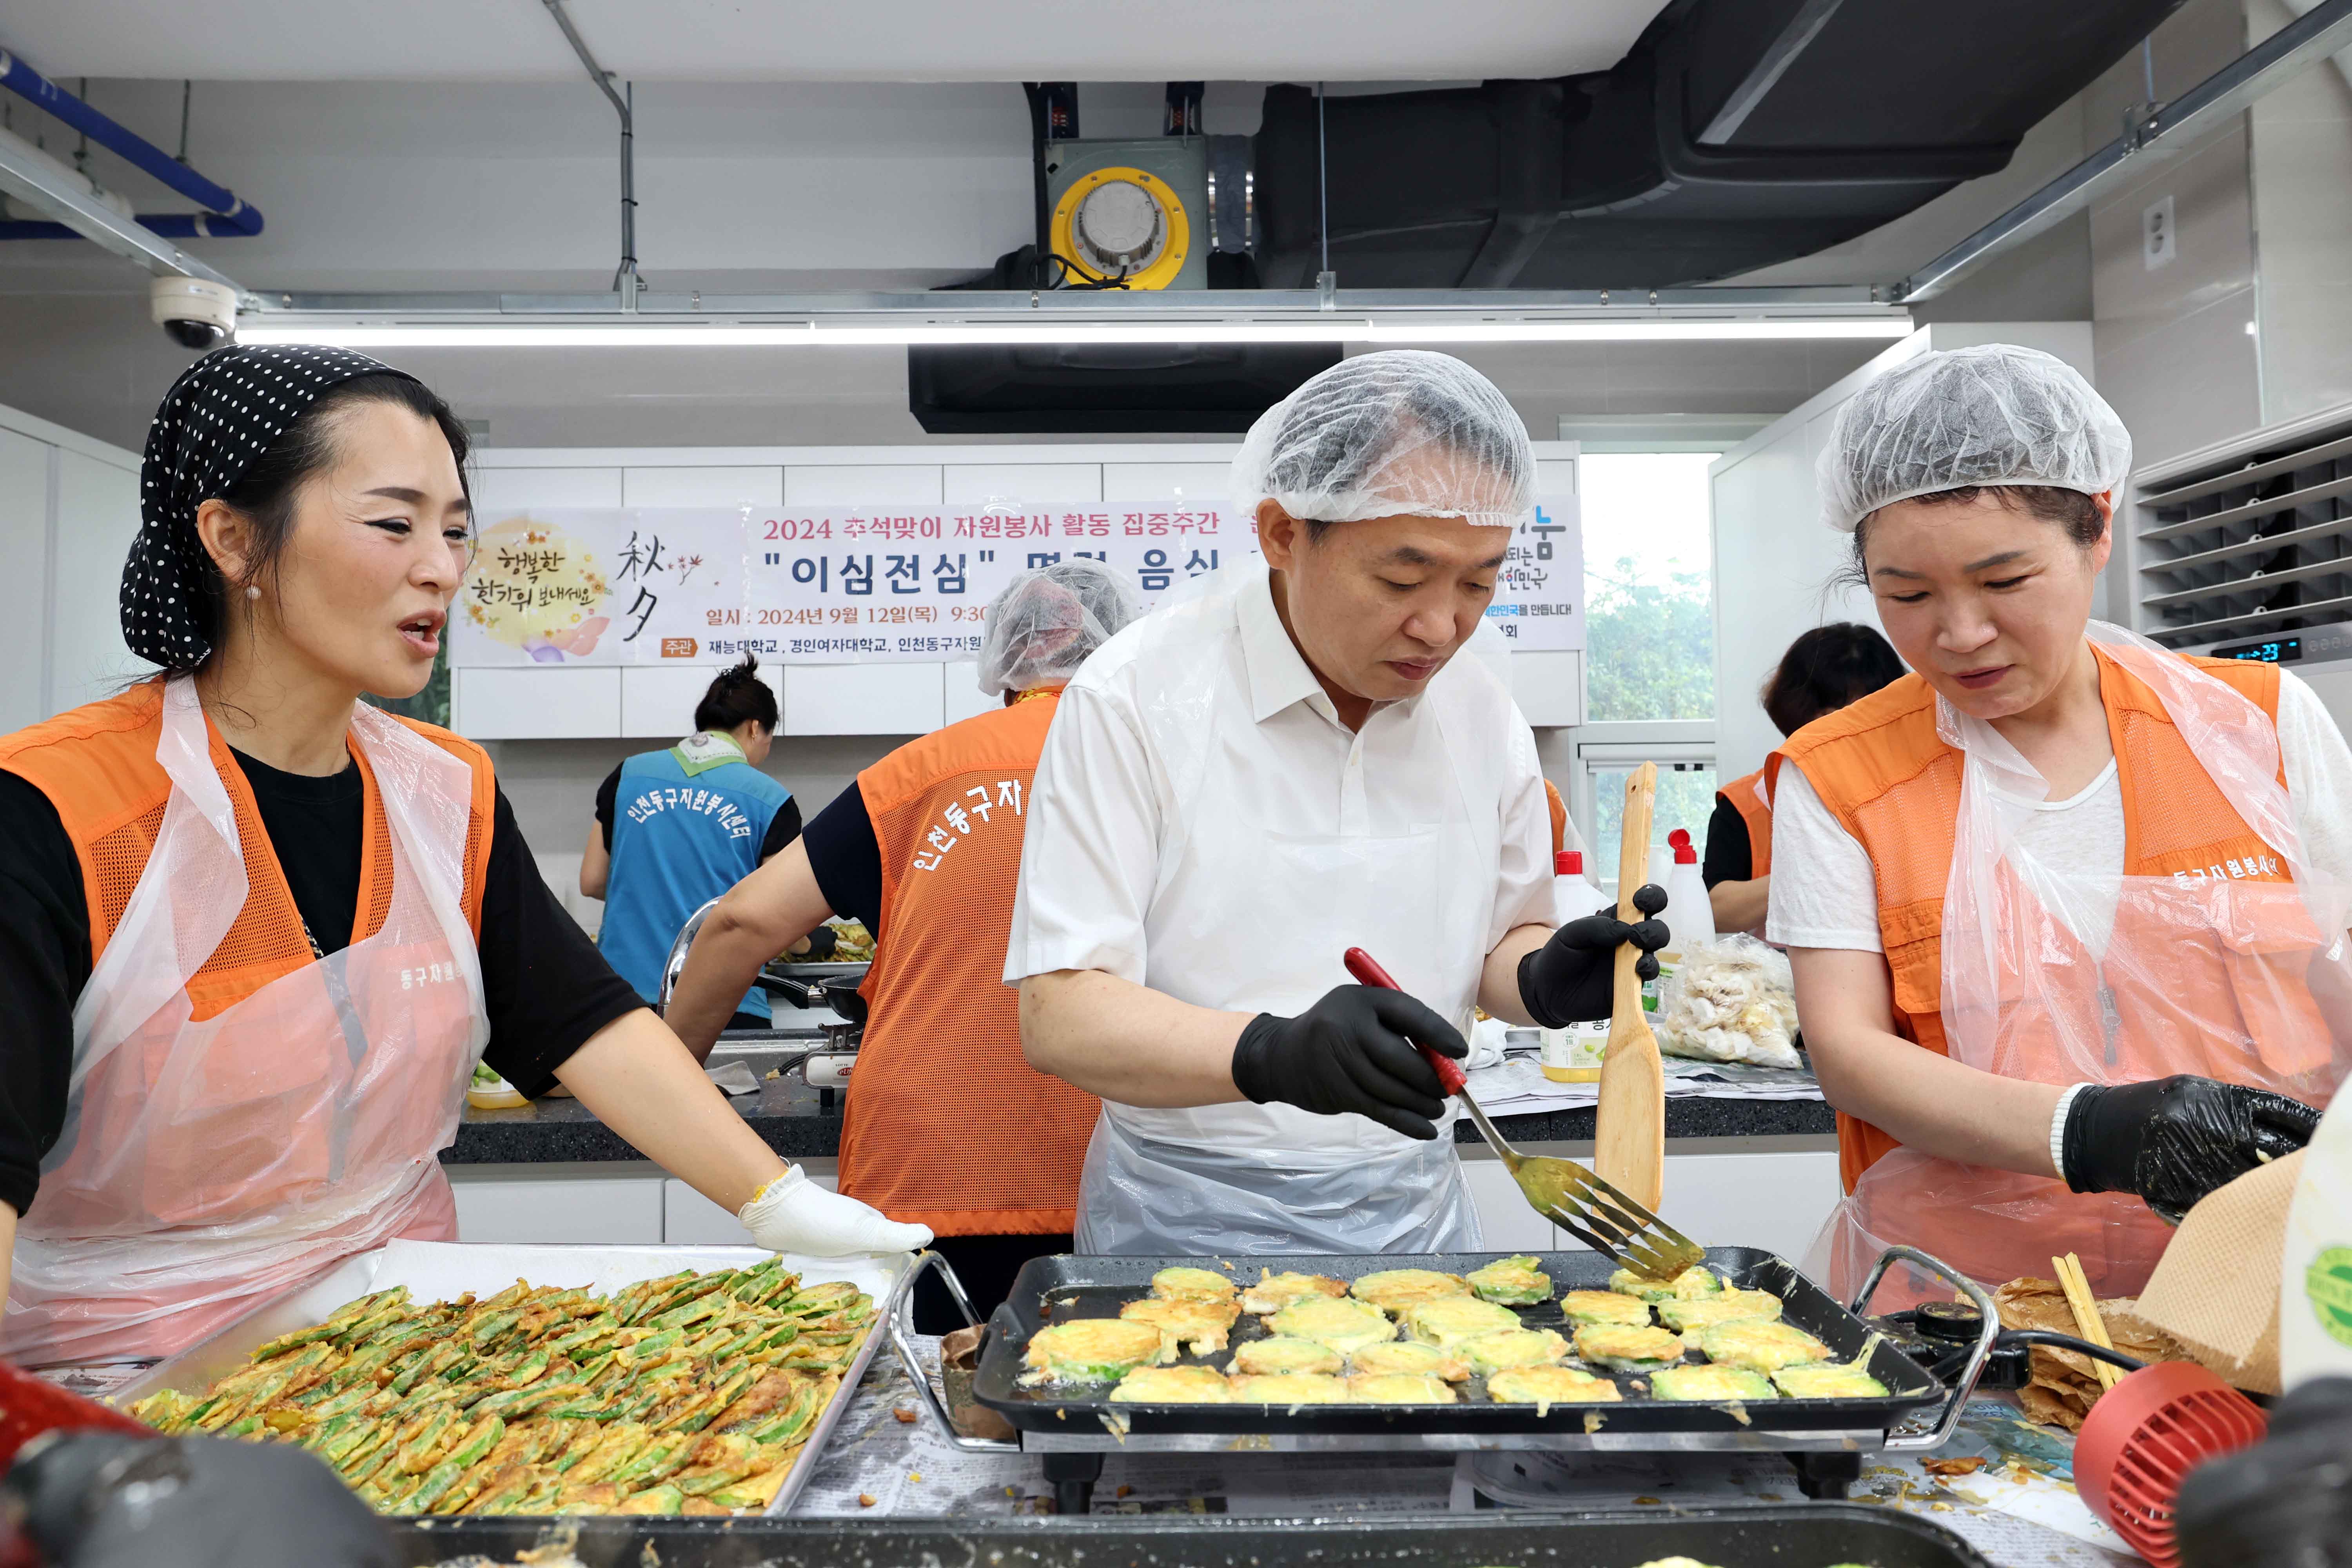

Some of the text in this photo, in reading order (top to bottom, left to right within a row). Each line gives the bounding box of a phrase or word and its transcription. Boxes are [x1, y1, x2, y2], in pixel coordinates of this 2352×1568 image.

[763, 511, 1220, 541] 2024 추석맞이 자원봉사 활동 집중주간
[1520, 505, 1566, 561] 눔
[497, 547, 566, 584] 행복한
[539, 586, 595, 606] 보내세요
[616, 531, 666, 642] 秋夕
[706, 608, 740, 626] 일시
[757, 608, 822, 625] 2024년
[829, 607, 858, 624] 9월
[867, 605, 938, 624] 12일(목)
[1531, 604, 1572, 617] 만듭니다!
[665, 639, 693, 655] 주관
[789, 637, 891, 654] 경인여자대학교,
[898, 635, 986, 652] 인천동구자원
[627, 788, 751, 839] 인천동구자원봉사센터
